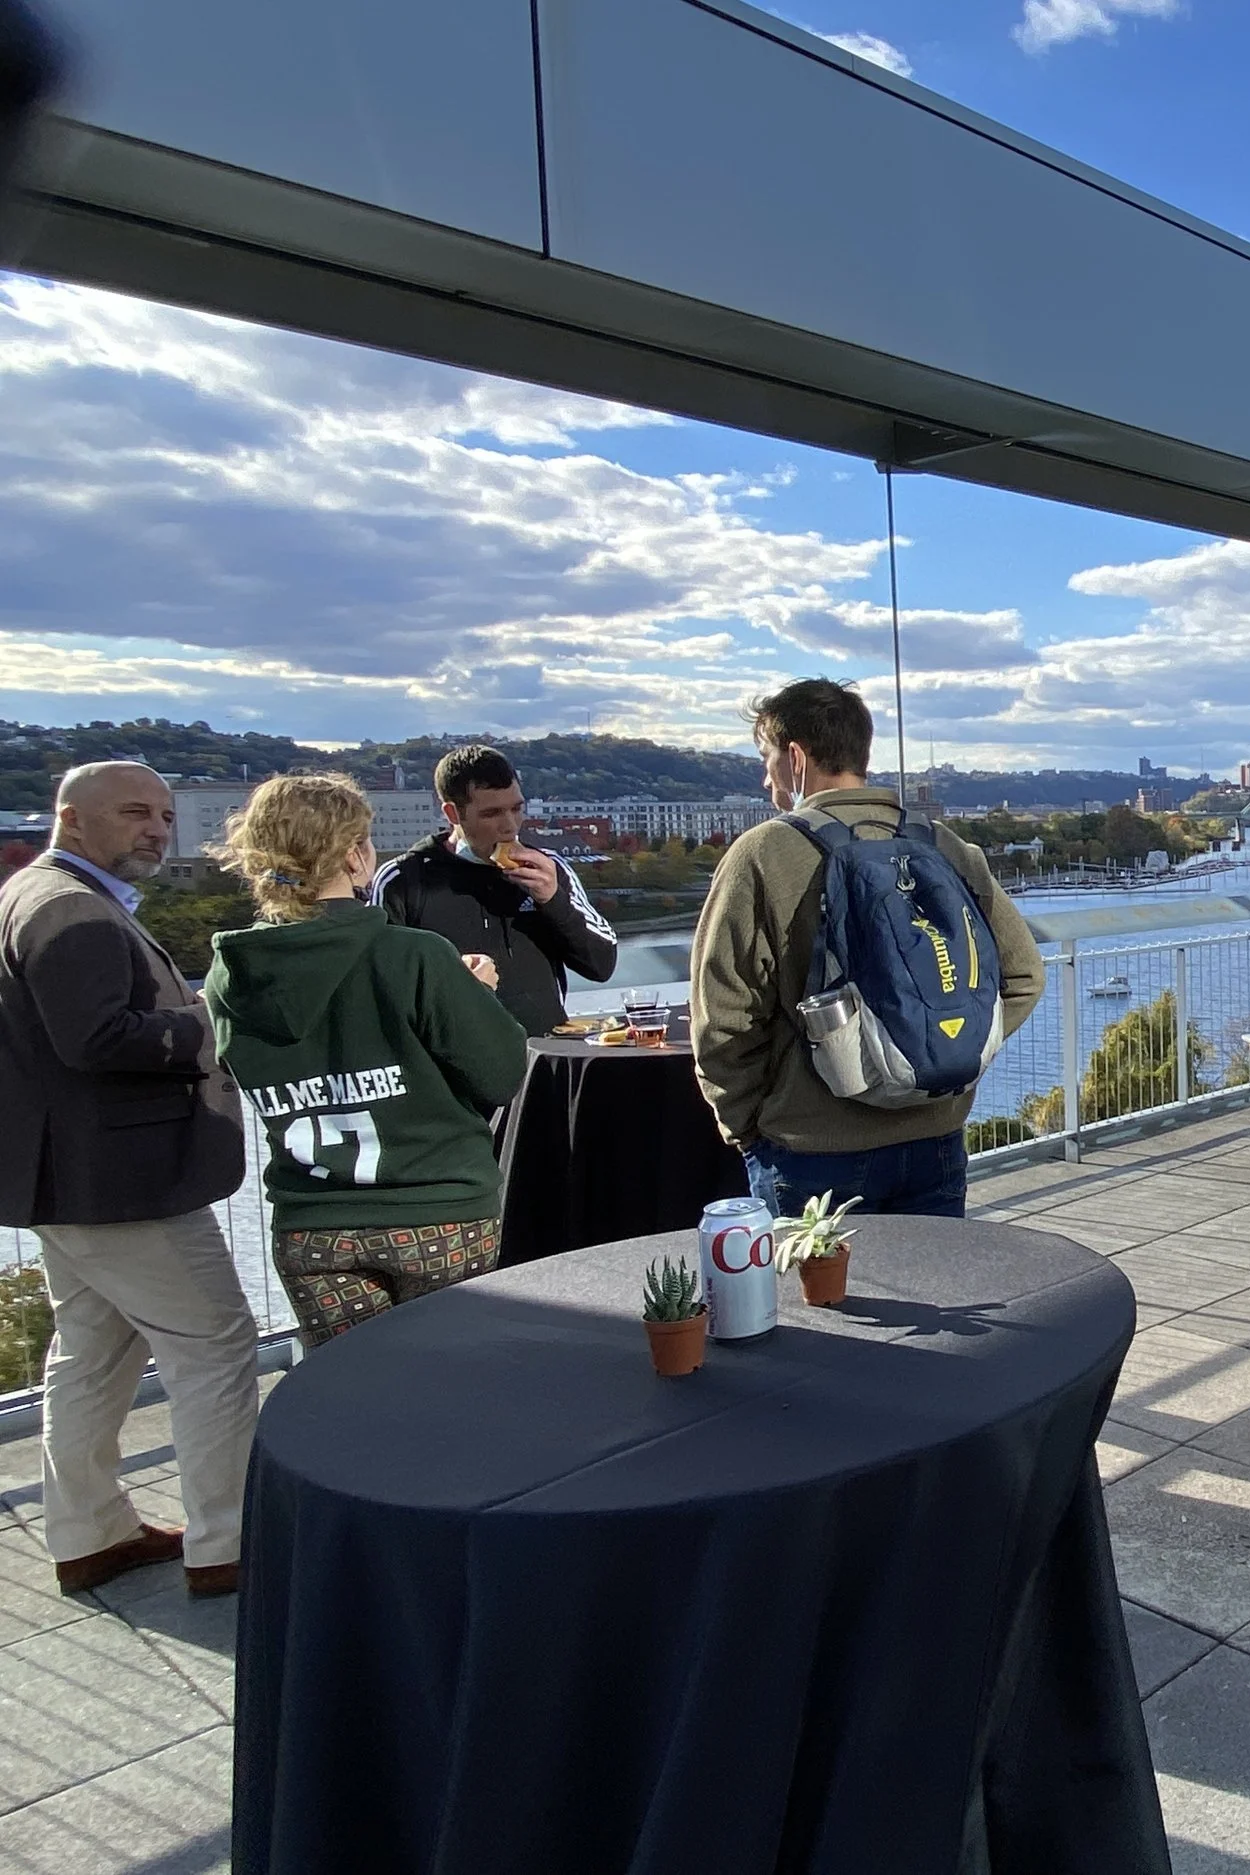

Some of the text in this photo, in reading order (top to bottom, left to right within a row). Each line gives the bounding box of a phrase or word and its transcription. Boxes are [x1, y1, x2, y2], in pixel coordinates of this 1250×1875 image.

[922, 926, 957, 993] Columbia
[285, 1077, 328, 1111] ME
[327, 1065, 407, 1105] MAEBE
[285, 1110, 382, 1185] 17
